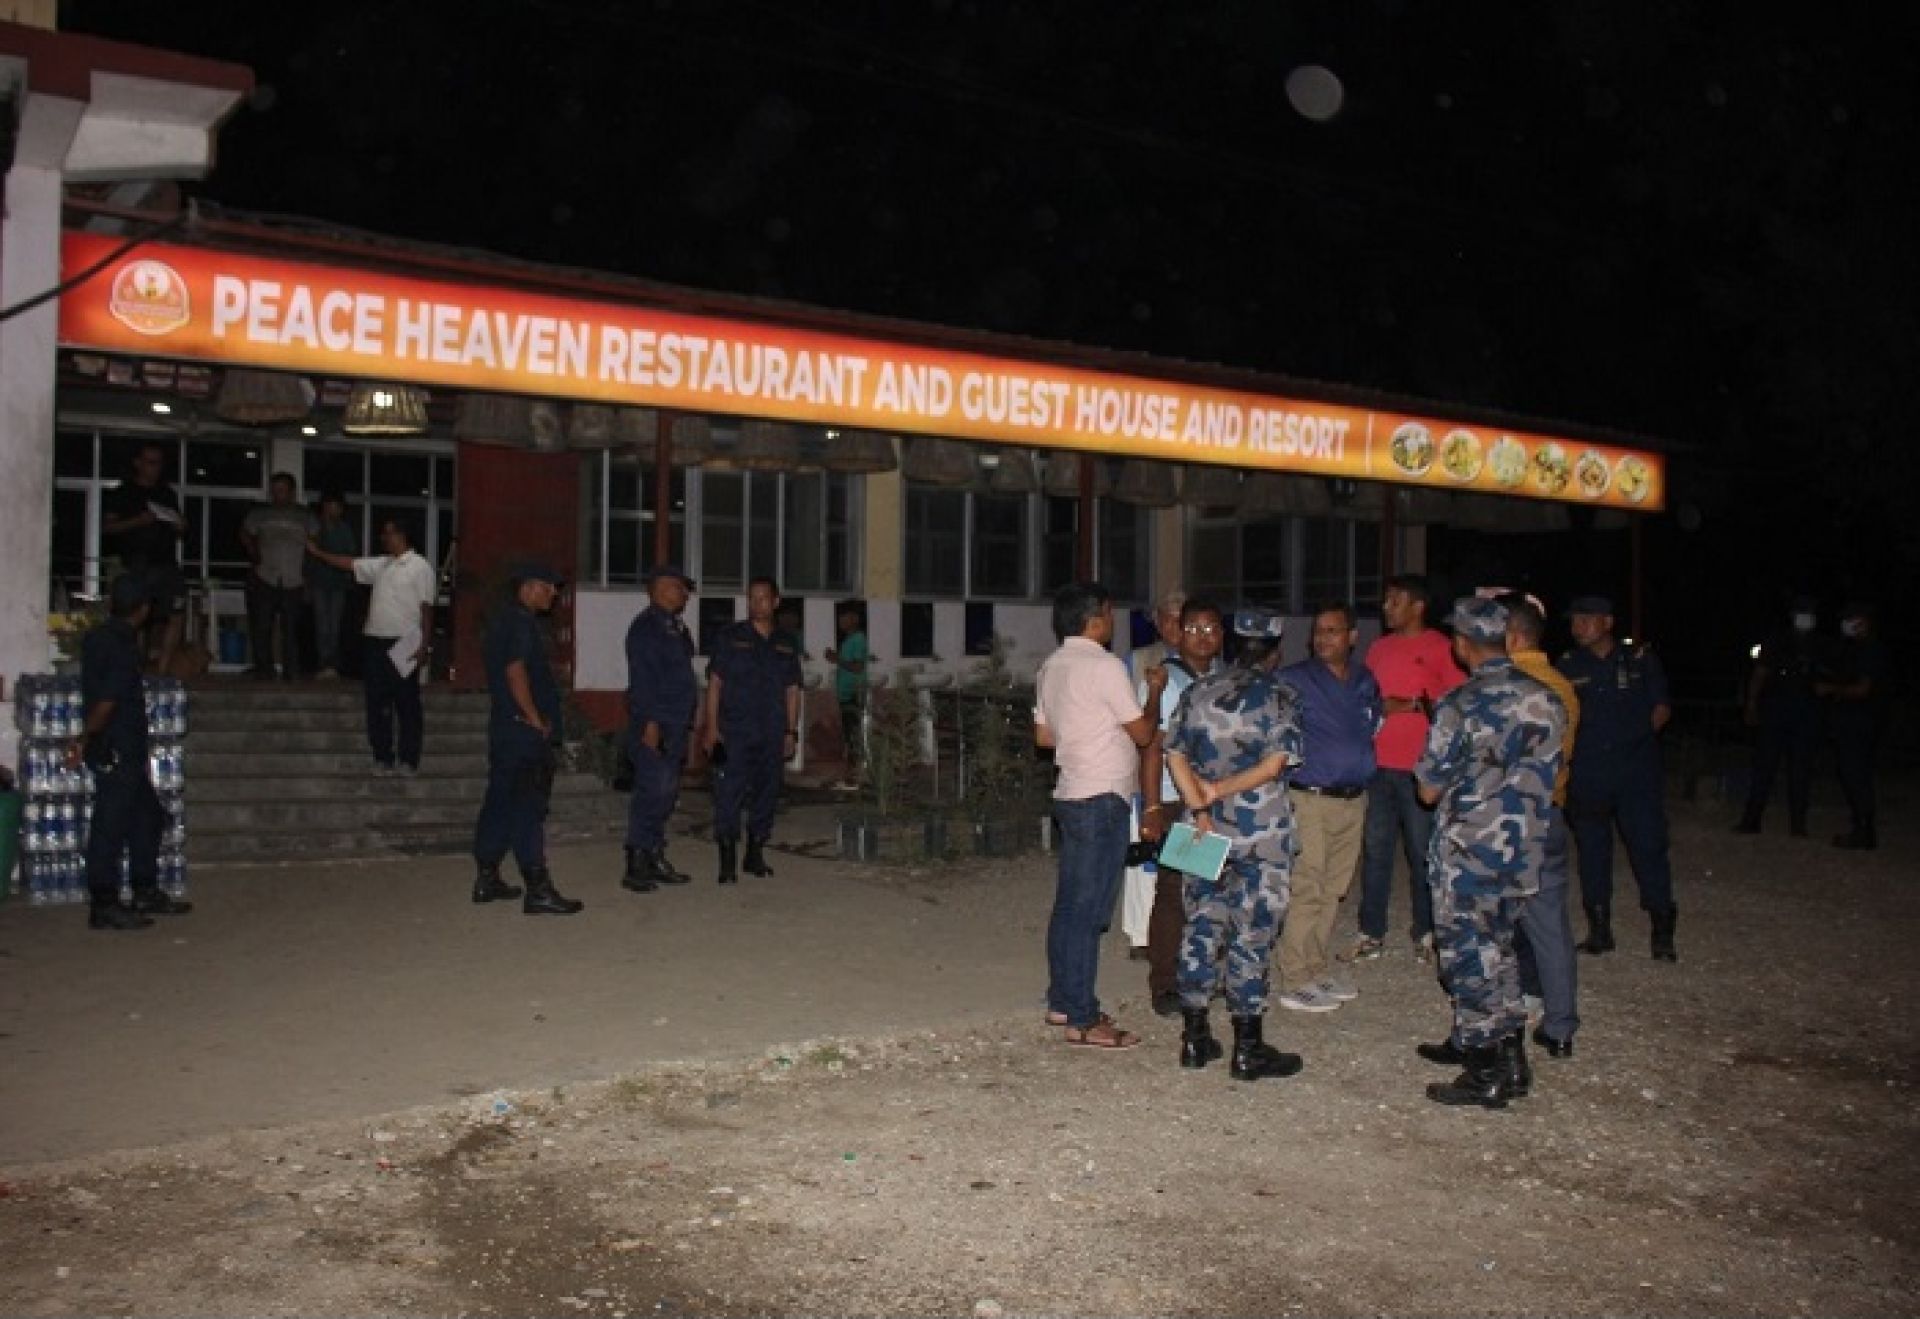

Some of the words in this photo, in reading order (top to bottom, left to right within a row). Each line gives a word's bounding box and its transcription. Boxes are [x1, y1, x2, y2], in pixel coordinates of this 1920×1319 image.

[212, 275, 384, 355] PEACE
[394, 298, 590, 378] HEAVEN
[598, 325, 868, 408] RESTAURANT
[872, 361, 953, 417] AND
[959, 372, 1071, 429] GUEST
[1074, 386, 1177, 442] HOUSE
[1182, 400, 1243, 448] AND
[1247, 408, 1350, 461] RESORT
